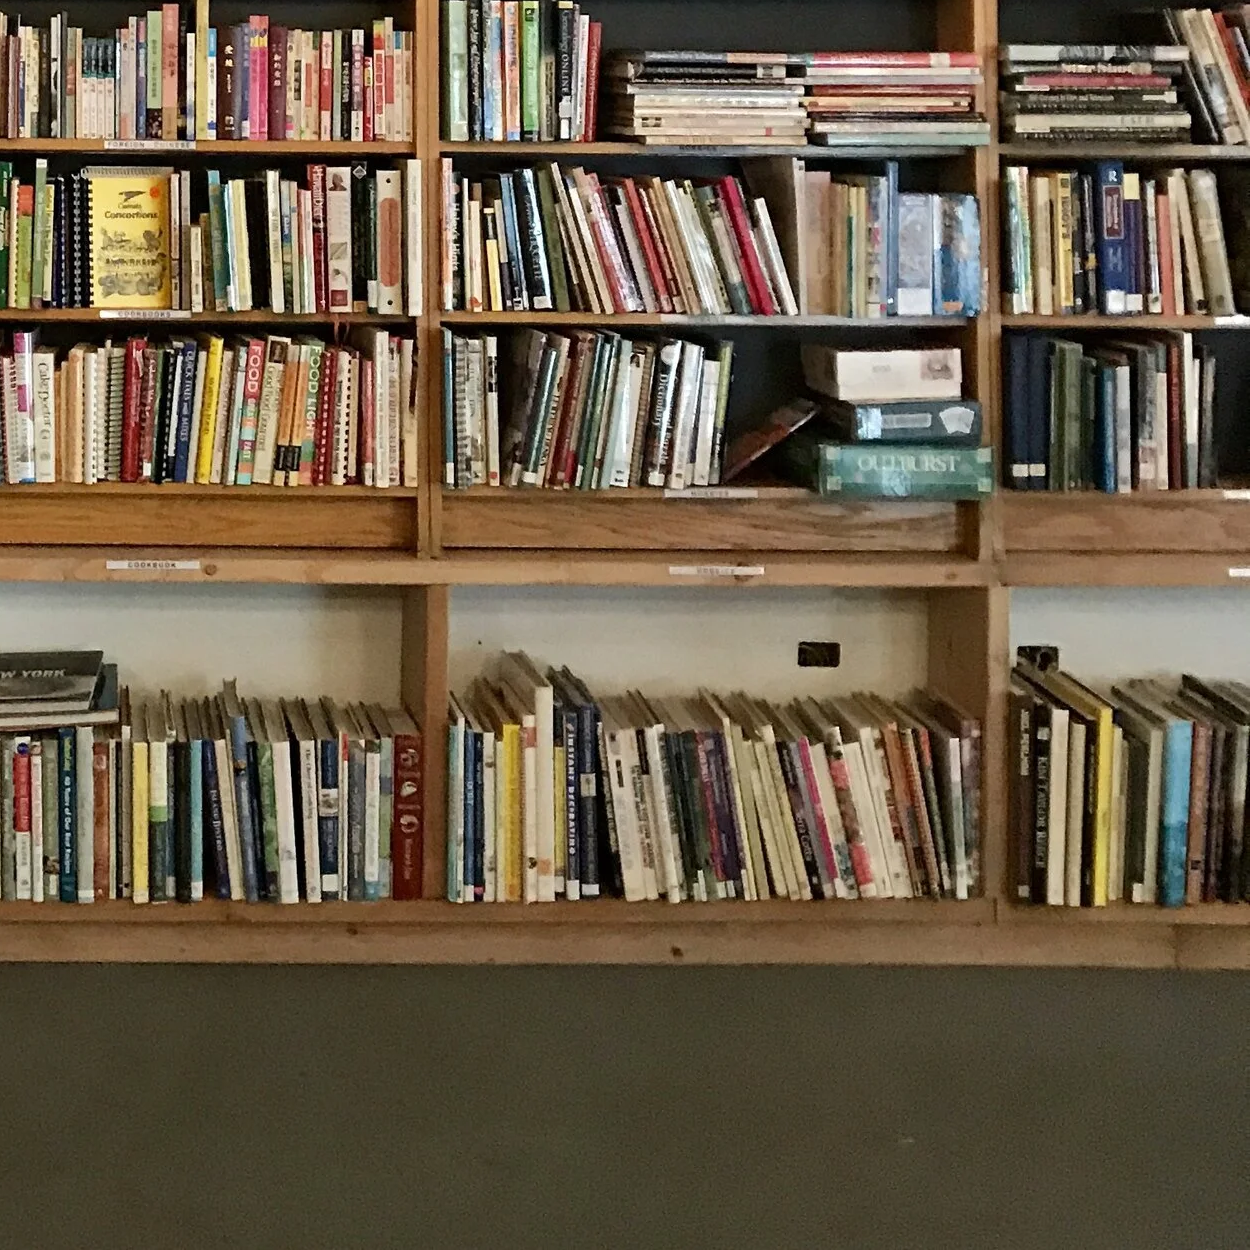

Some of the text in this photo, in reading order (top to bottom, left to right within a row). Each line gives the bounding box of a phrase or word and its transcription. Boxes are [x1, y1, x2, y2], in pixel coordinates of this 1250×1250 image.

[560, 10, 572, 93] Genealogy ONLINE
[104, 210, 158, 219] Concoctions
[452, 243, 461, 271] Hints
[184, 350, 195, 378] QUICK
[37, 362, 52, 426] Cake Doctor
[242, 346, 262, 459] FOOD FAST
[306, 346, 323, 439] FOOD LIGHT
[652, 373, 669, 427] Dictionary
[179, 416, 189, 442] MIXES
[858, 454, 962, 473] OUTBURST
[128, 561, 177, 569] COOKBOOK
[21, 668, 67, 679] YORK
[1037, 756, 1048, 779] KIM
[63, 787, 71, 806] Years
[567, 733, 576, 855] INSTANT DECORATING
[1036, 784, 1047, 827] TAYLOR
[63, 816, 71, 831] Our
[209, 789, 224, 851] ISLAND BISTRO
[63, 832, 71, 846] Best
[63, 848, 71, 874] Recipes
